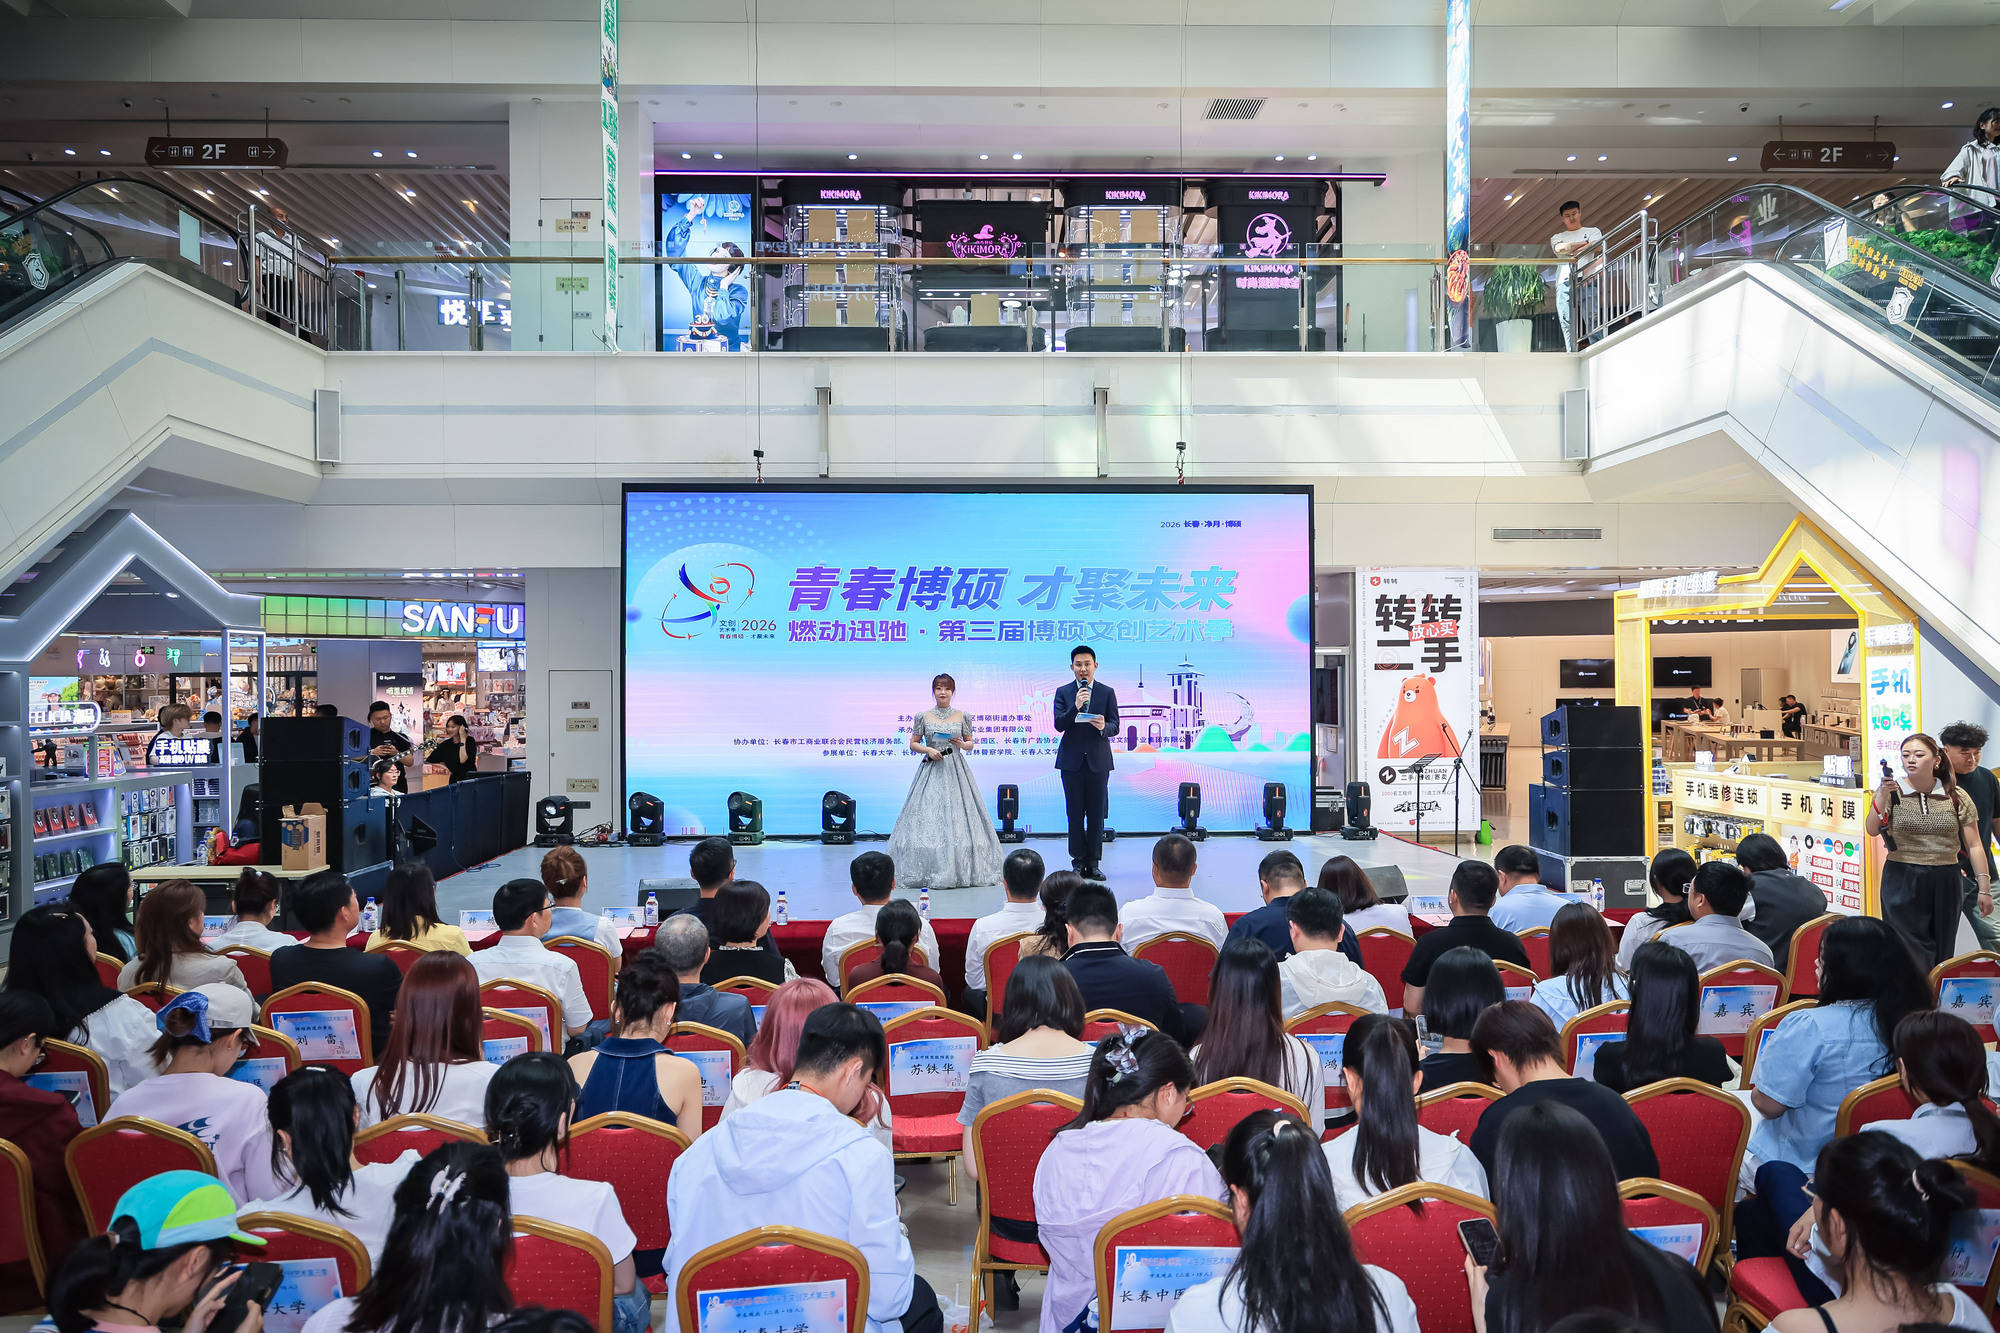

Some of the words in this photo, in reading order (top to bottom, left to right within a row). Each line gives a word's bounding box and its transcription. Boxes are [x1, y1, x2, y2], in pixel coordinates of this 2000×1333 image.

[202, 144, 226, 160] 2F
[1819, 147, 1843, 163] 2F
[820, 189, 862, 201] KIKIMORA
[1105, 190, 1147, 201] KIKIMORA
[1248, 190, 1290, 202] KIKIMORA
[1160, 520, 1181, 528] 2026
[787, 565, 1010, 612] 青春博硕
[1016, 565, 1239, 612] 才聚未来
[401, 603, 519, 634] SANFU
[1375, 593, 1462, 633] 转转
[741, 619, 777, 631] 2026
[1411, 621, 1455, 640] 放心买
[1374, 636, 1462, 674] 二手
[1870, 667, 1912, 696] 手机
[1871, 703, 1913, 731] 贴膜
[155, 739, 211, 756] 手机贴膜
[1685, 780, 1758, 806] 手机维修连锁
[1780, 792, 1856, 821] 手机贴膜
[1713, 1001, 1755, 1018] 嘉宾
[910, 1062, 955, 1076] 苏铁华
